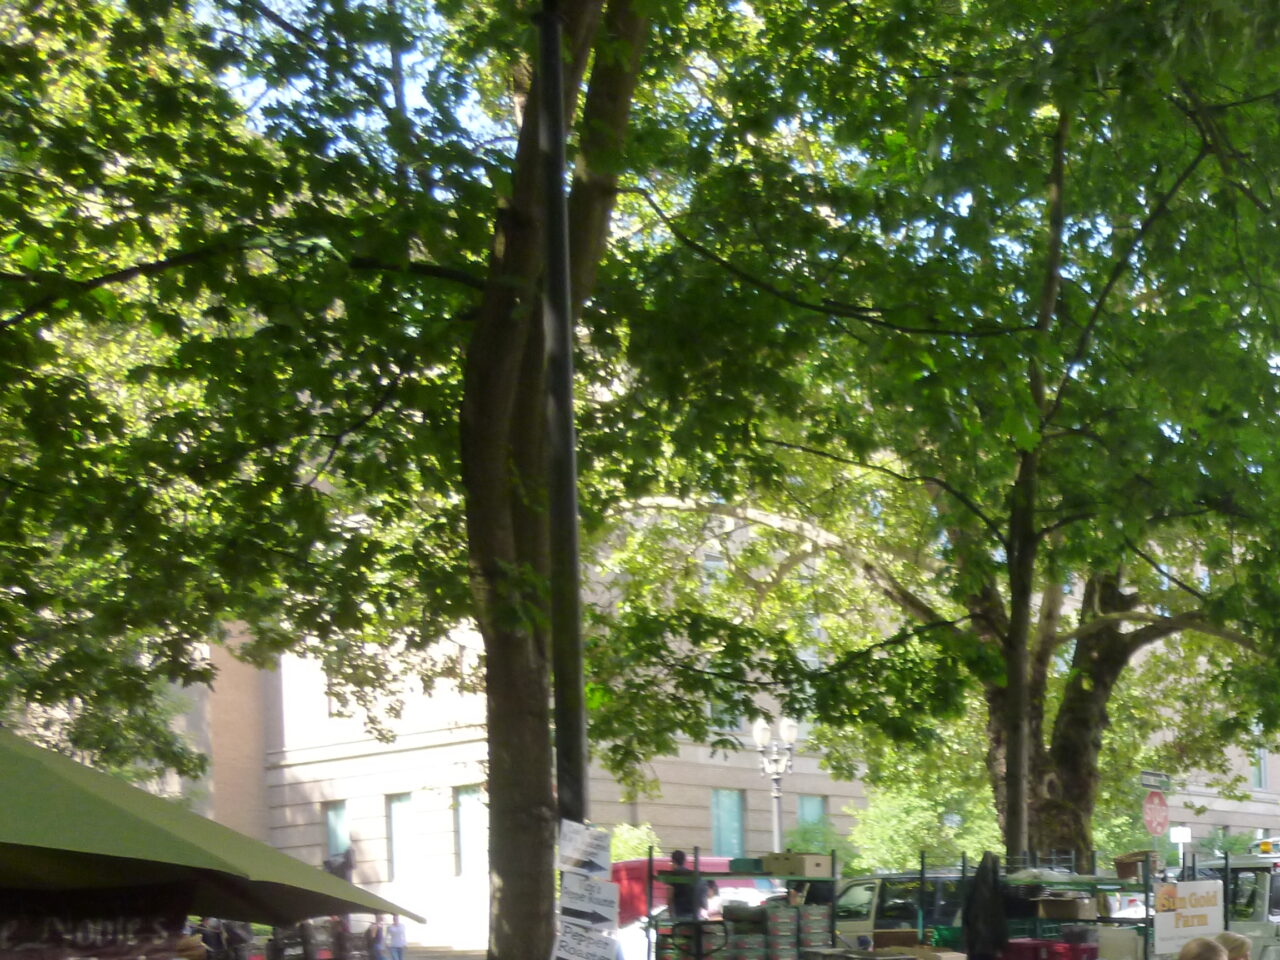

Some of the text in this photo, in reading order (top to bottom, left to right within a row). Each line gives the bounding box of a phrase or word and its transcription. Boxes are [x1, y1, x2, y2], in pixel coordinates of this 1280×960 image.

[1189, 891, 1218, 908] Gold
[1174, 911, 1208, 928] Farm
[562, 924, 609, 950] Pepper
